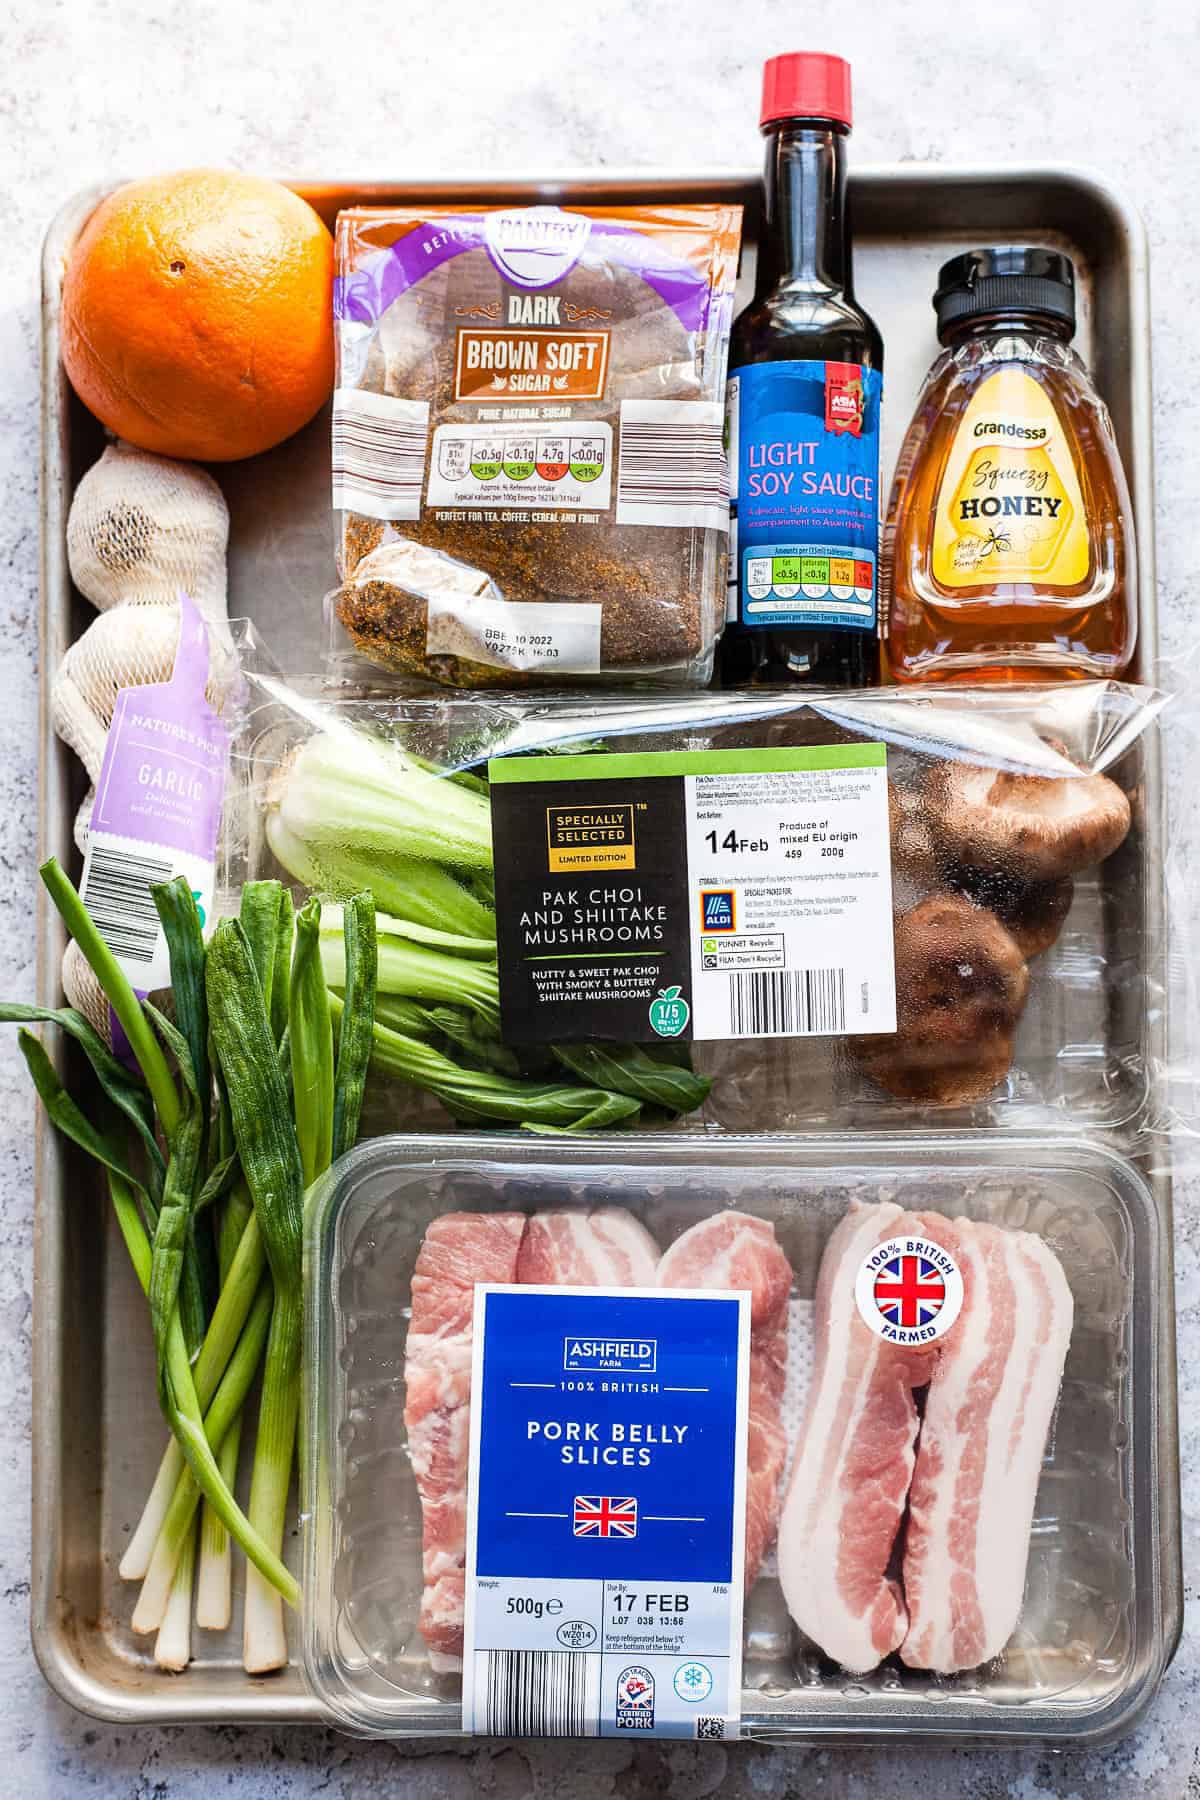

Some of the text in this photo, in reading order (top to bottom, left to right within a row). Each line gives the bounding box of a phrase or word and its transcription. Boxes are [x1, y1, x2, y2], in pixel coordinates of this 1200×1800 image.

[508, 296, 561, 324] DARK
[467, 341, 598, 371] BROWN SOFT
[509, 374, 551, 392] SUGAR
[478, 407, 572, 419] PURE NATURAL SUGAR
[973, 422, 1047, 440] Grandessa
[473, 449, 502, 462] <0.5g
[506, 449, 535, 462] <0.1g
[542, 449, 564, 463] 4.7g
[571, 450, 603, 464] <0.01g
[748, 442, 820, 468] LIGHT
[973, 460, 1050, 491] Squeezy
[747, 471, 874, 501] SOY SAUCE
[960, 496, 1062, 520] HONEY
[435, 511, 468, 521] PERFECT
[468, 511, 482, 521] FOR
[532, 512, 559, 522] CEREAL
[578, 513, 601, 524] FRUIT
[776, 569, 798, 579] <0.5g
[805, 569, 827, 580] <0.1g
[835, 571, 850, 581] 1.2g
[529, 636, 553, 645] 2022
[138, 764, 203, 801] GARLIC
[556, 814, 625, 828] SPECIALLY
[779, 820, 829, 831] Produce of
[557, 829, 626, 842] SELECTED
[779, 831, 858, 844] mixed EU origin
[558, 853, 627, 864] LIMITED EDITION
[784, 847, 844, 859] 459 200g
[542, 887, 642, 906] PAK CHOI
[519, 905, 668, 926] AND SHIITAKE
[706, 915, 731, 925] ALDI
[524, 925, 664, 945] MUSHROOMS
[718, 938, 774, 948] PUNNET Recycle
[718, 956, 735, 964] FILM
[756, 953, 782, 963] Recycle
[531, 966, 660, 980] NUTTY & SWEET PAK CHOI
[535, 976, 657, 991] WITH SMOKY & BUTTERY
[539, 989, 652, 1002] SHIITAKE MUSHROOMS
[658, 1004, 679, 1019] 1/5
[866, 1241, 955, 1275] 100% BRITISH
[881, 1324, 937, 1343] FARMED
[570, 1342, 652, 1358] ASHFIELD
[599, 1359, 622, 1367] FARM
[561, 1381, 659, 1393] 100% BRITISH
[527, 1421, 689, 1444] PORK BELLY
[560, 1446, 652, 1466] SLICES
[613, 1593, 689, 1612] 17 FEB
[571, 1623, 583, 1631] UK
[612, 1616, 629, 1625] L07
[637, 1616, 654, 1625] 038
[562, 1630, 591, 1639] WZ014
[655, 1634, 673, 1643] below
[616, 1717, 653, 1728] PORK
